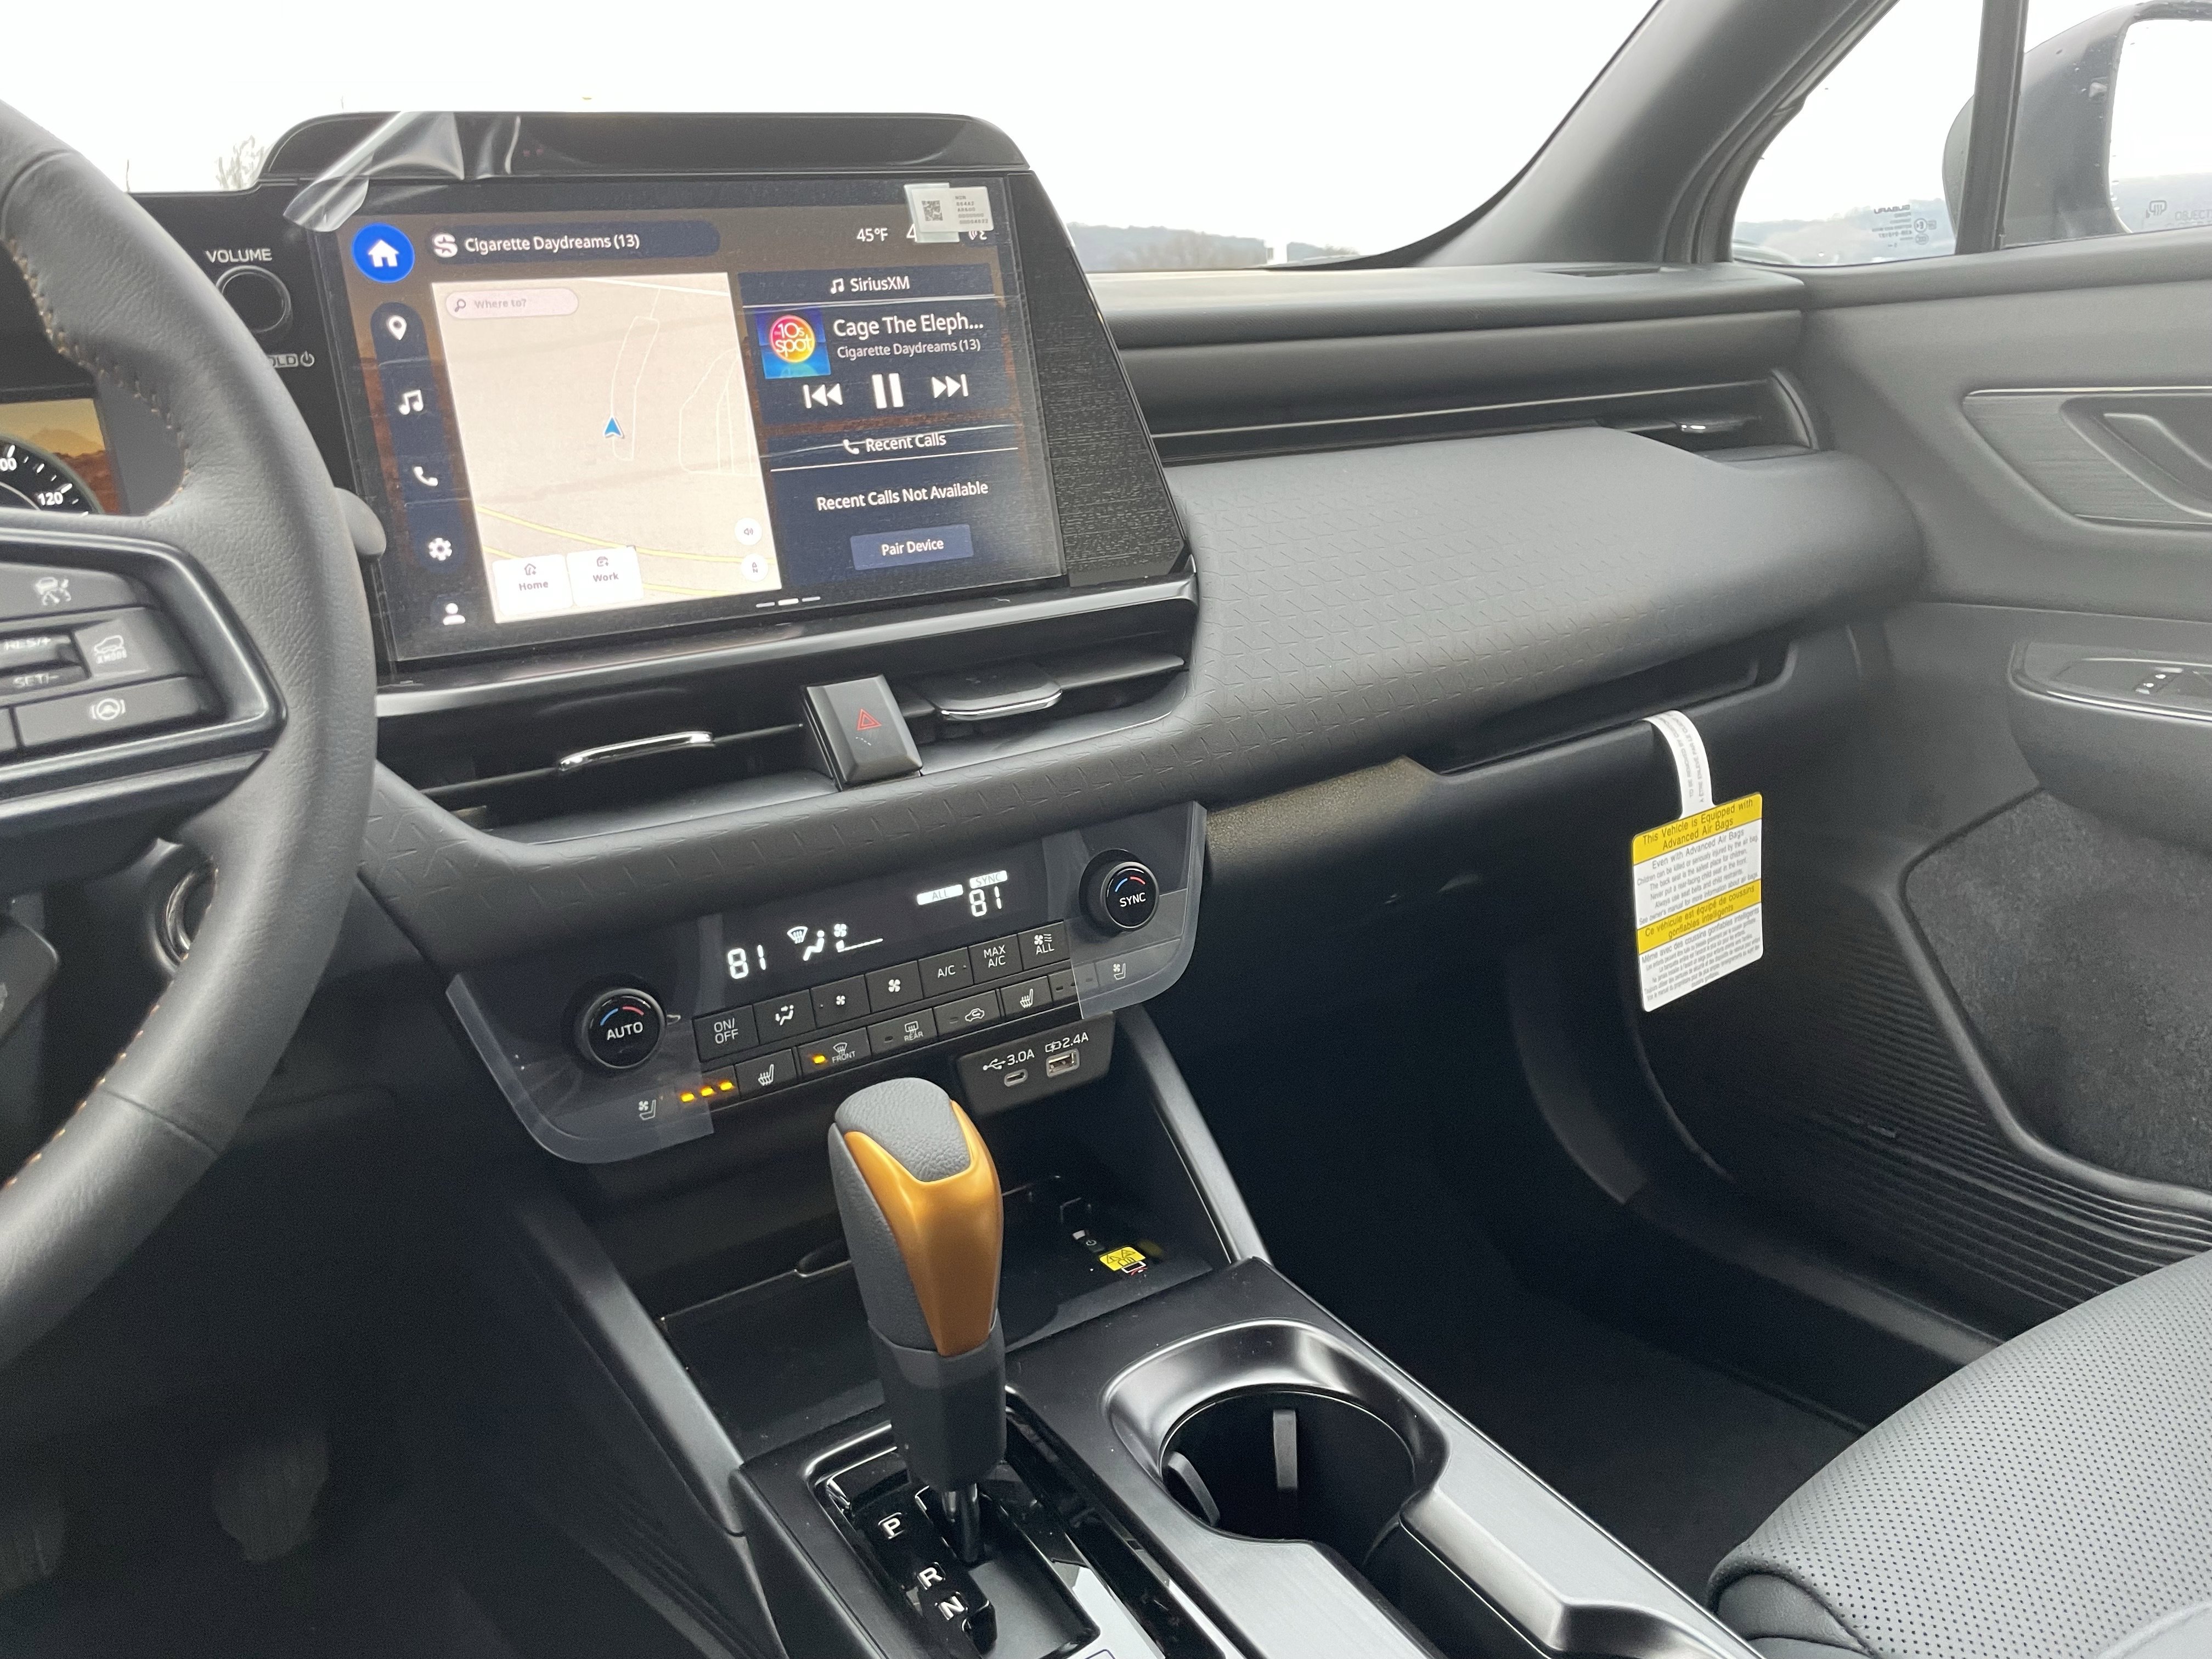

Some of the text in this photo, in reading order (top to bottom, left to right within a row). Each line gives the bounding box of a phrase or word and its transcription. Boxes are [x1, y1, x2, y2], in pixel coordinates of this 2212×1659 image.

[465, 236, 531, 254] Cigarette
[534, 234, 611, 252] Daydreams
[613, 234, 640, 250] (13)
[206, 248, 272, 263] VOLUME
[850, 276, 910, 292] SiriusXM
[475, 297, 527, 309] Where to?
[833, 318, 879, 338] Cage
[883, 317, 916, 332] The
[775, 334, 812, 357] spot
[837, 338, 981, 361] Cigarette Daydreams (13)
[866, 432, 946, 452] Recent Calls
[0, 458, 16, 471] 00
[38, 492, 63, 506] 120
[817, 481, 989, 511] Recent Calls Not Available
[881, 538, 944, 556] Pair Device
[519, 580, 548, 591] Home
[593, 572, 619, 583] Work
[1643, 798, 1752, 845] This Vehicle is Equipped with
[1662, 817, 1733, 850] Advanced Air Bags
[1652, 828, 1743, 868] Even with Advanced Air Bags
[976, 873, 1001, 887] SYNC
[933, 890, 950, 900] ALL
[969, 885, 1002, 917] 81
[1119, 893, 1146, 907] SYNC
[1645, 885, 1754, 936] Ce véhicule est équipé de coussins
[1668, 906, 1733, 939] gonflables intelligents
[984, 945, 1006, 958] MAX
[1036, 943, 1054, 955] ALL
[727, 945, 766, 979] 81
[988, 955, 1006, 968] A/C
[937, 965, 956, 978] A/C
[606, 1022, 644, 1040] AUTO
[714, 1018, 735, 1032] ON/
[715, 1029, 738, 1044] OFF
[904, 1031, 923, 1042] REAR
[1062, 1032, 1089, 1048] 2.4A
[832, 1050, 856, 1063] FRONT
[1007, 1051, 1035, 1066] 3.0A
[882, 1517, 901, 1536] P
[919, 1566, 942, 1587] R
[939, 1595, 965, 1620] N
